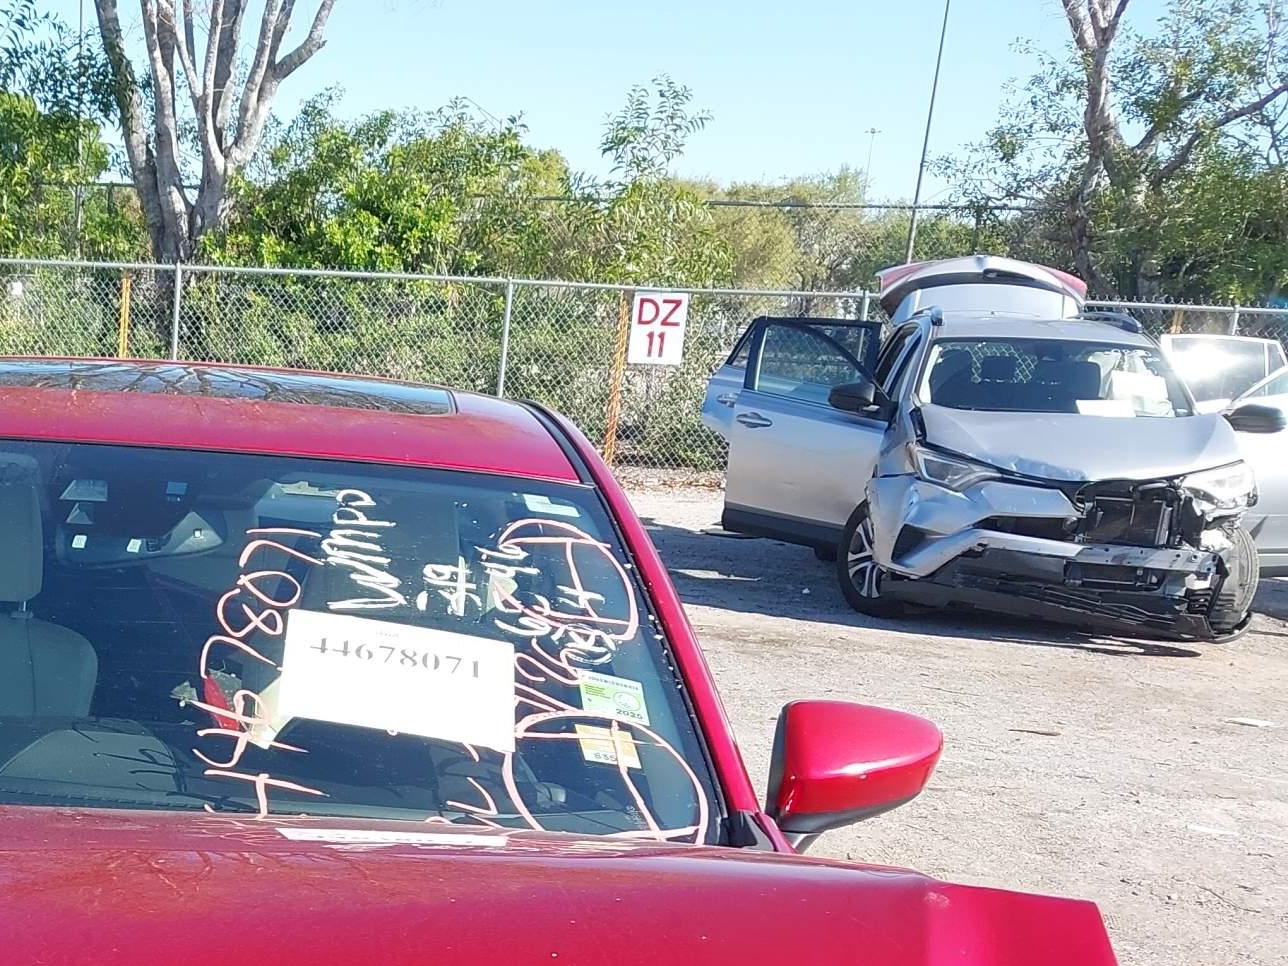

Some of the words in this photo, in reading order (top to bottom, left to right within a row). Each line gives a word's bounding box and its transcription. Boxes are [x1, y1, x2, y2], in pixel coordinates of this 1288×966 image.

[637, 298, 682, 326] DZ
[646, 331, 665, 357] 11
[310, 637, 479, 678] 44678071
[616, 708, 643, 720] 2025
